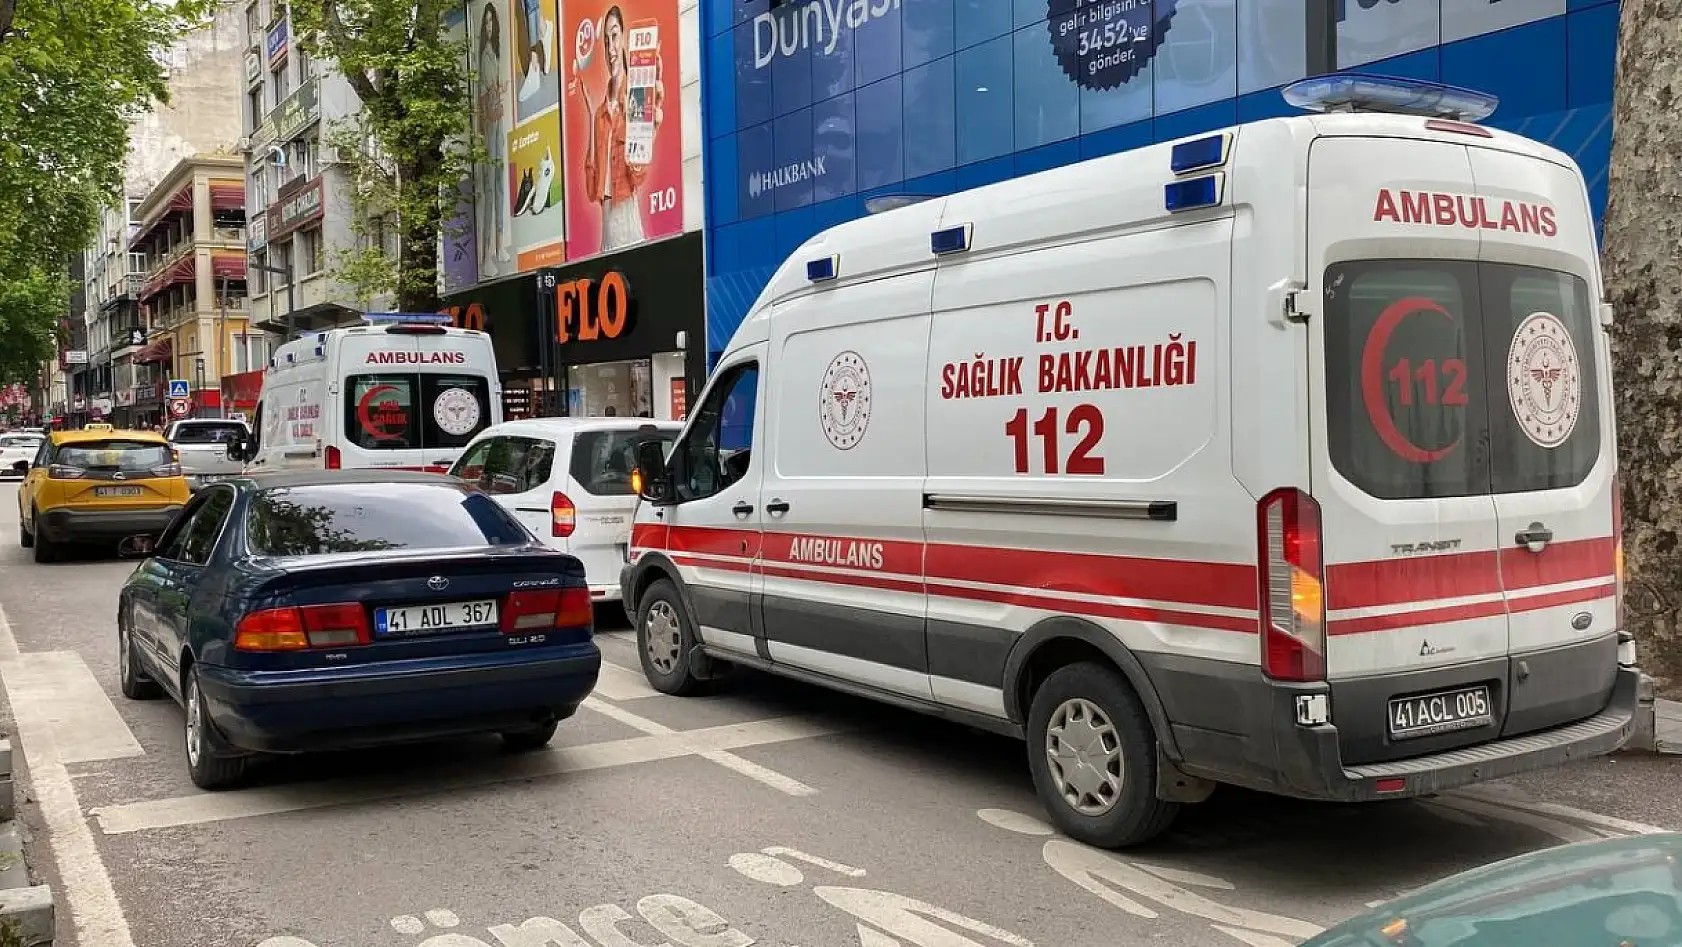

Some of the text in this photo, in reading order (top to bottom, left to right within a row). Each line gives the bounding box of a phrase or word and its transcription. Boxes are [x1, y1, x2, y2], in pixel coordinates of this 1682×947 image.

[1060, 12, 1087, 37] gelir
[1089, 48, 1135, 75] gönder.
[762, 155, 826, 192] HALKBANK
[649, 187, 676, 215] FLO
[1373, 188, 1558, 237] AMBULANS
[555, 271, 628, 344] FLO
[1035, 300, 1080, 343] T.C.
[365, 351, 466, 365] AMBULANS
[941, 333, 1197, 400] SAĞLIK BAKANLIĞI
[1388, 358, 1469, 406] 112
[1004, 403, 1105, 476] 112
[788, 533, 885, 570] AMBULANS
[389, 609, 408, 631] 41
[421, 605, 453, 628] ADL
[462, 601, 493, 624] 367
[1395, 700, 1414, 727] 41
[1417, 695, 1454, 726] ACL
[1456, 689, 1486, 718] 005
